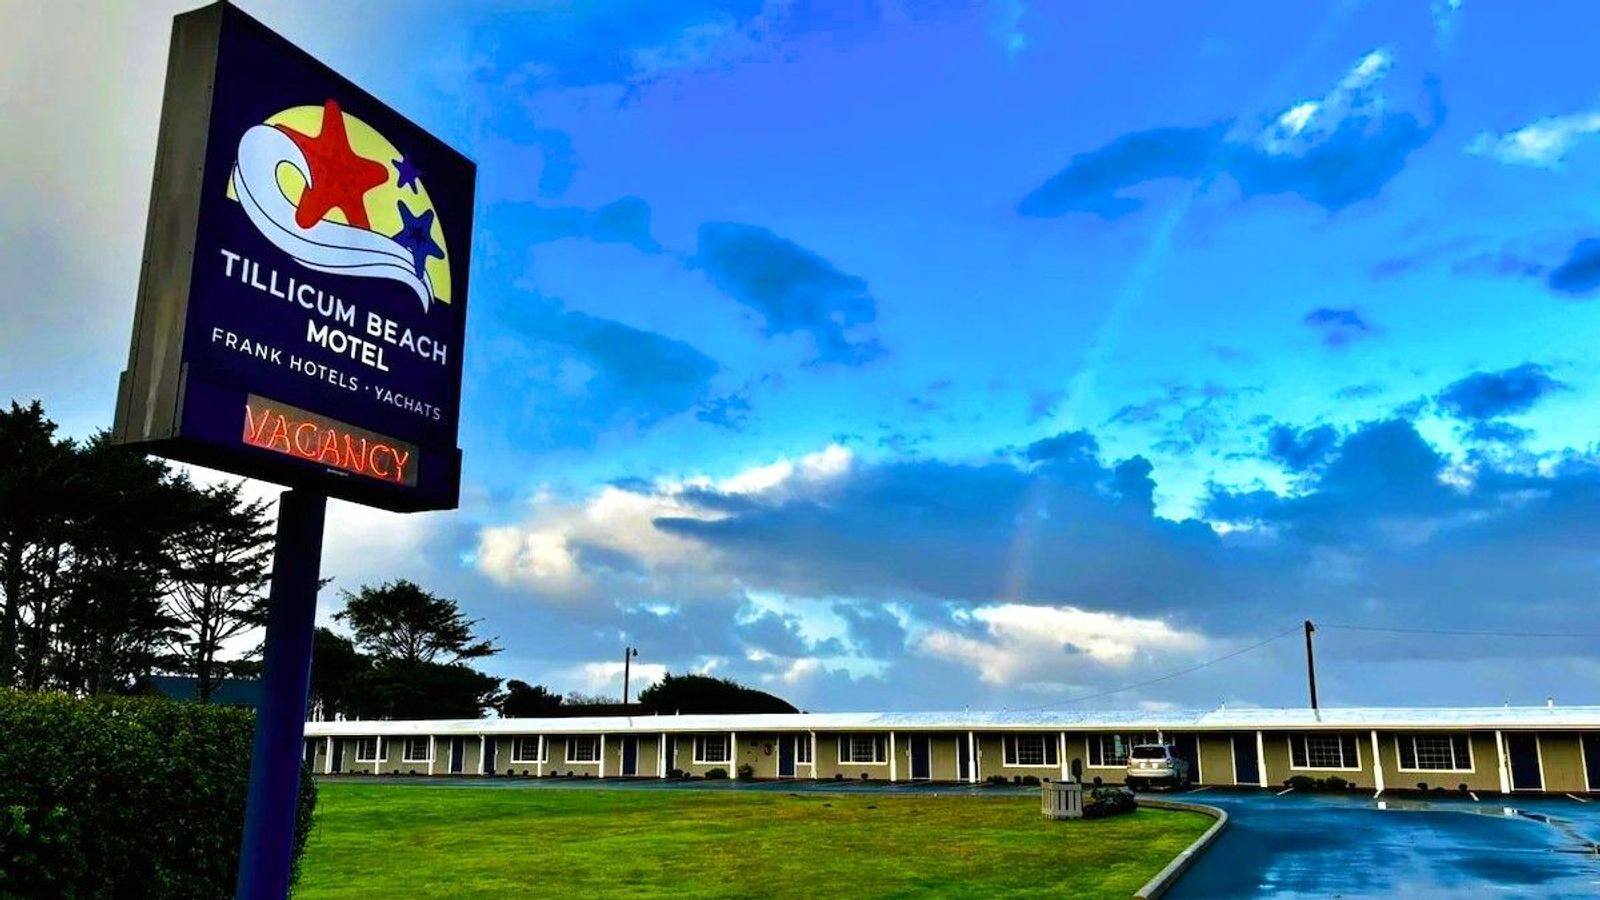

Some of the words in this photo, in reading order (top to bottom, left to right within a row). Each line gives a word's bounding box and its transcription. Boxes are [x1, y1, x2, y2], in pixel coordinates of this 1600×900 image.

[221, 249, 356, 328] TILLICUM
[366, 312, 447, 365] BEACH
[306, 319, 390, 372] MOTEL
[212, 327, 281, 365] FRANK
[290, 355, 359, 391] HOTELS
[374, 385, 441, 420] YACHATS
[245, 404, 409, 481] VACANCY
